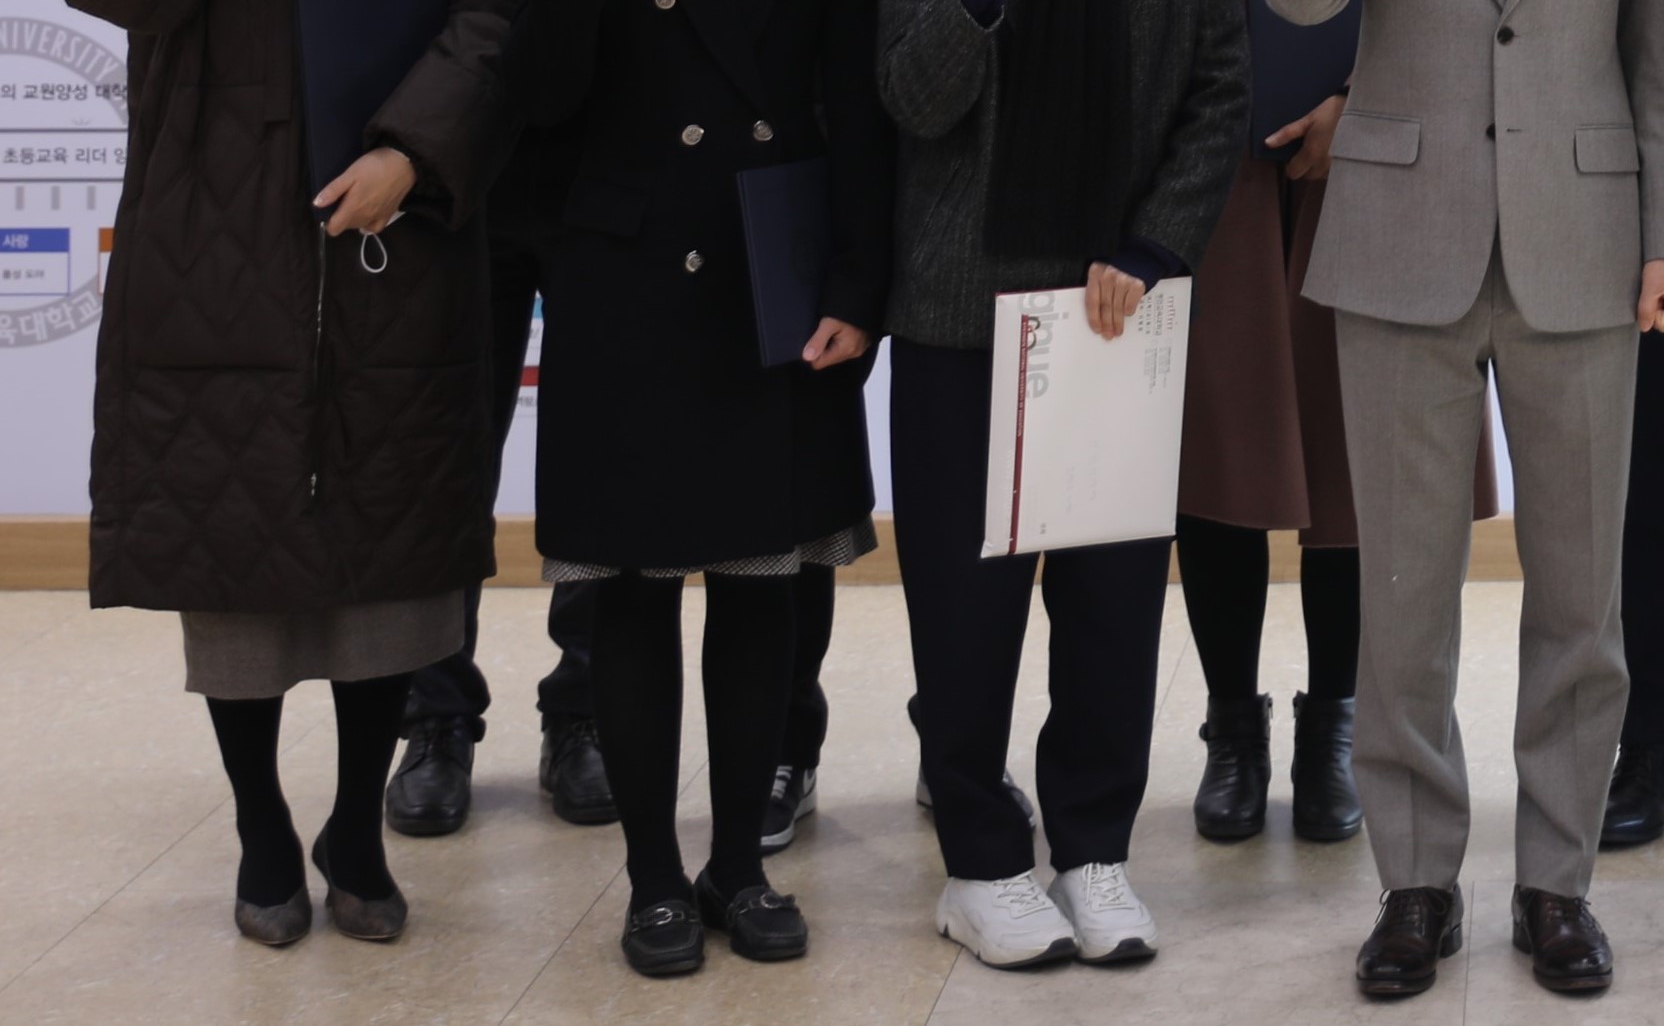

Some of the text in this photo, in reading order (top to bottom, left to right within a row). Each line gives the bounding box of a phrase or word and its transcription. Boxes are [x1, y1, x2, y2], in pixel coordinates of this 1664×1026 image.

[23, 83, 88, 101] 교원양성
[3, 147, 67, 165] 초등교육
[75, 147, 107, 164] 리더
